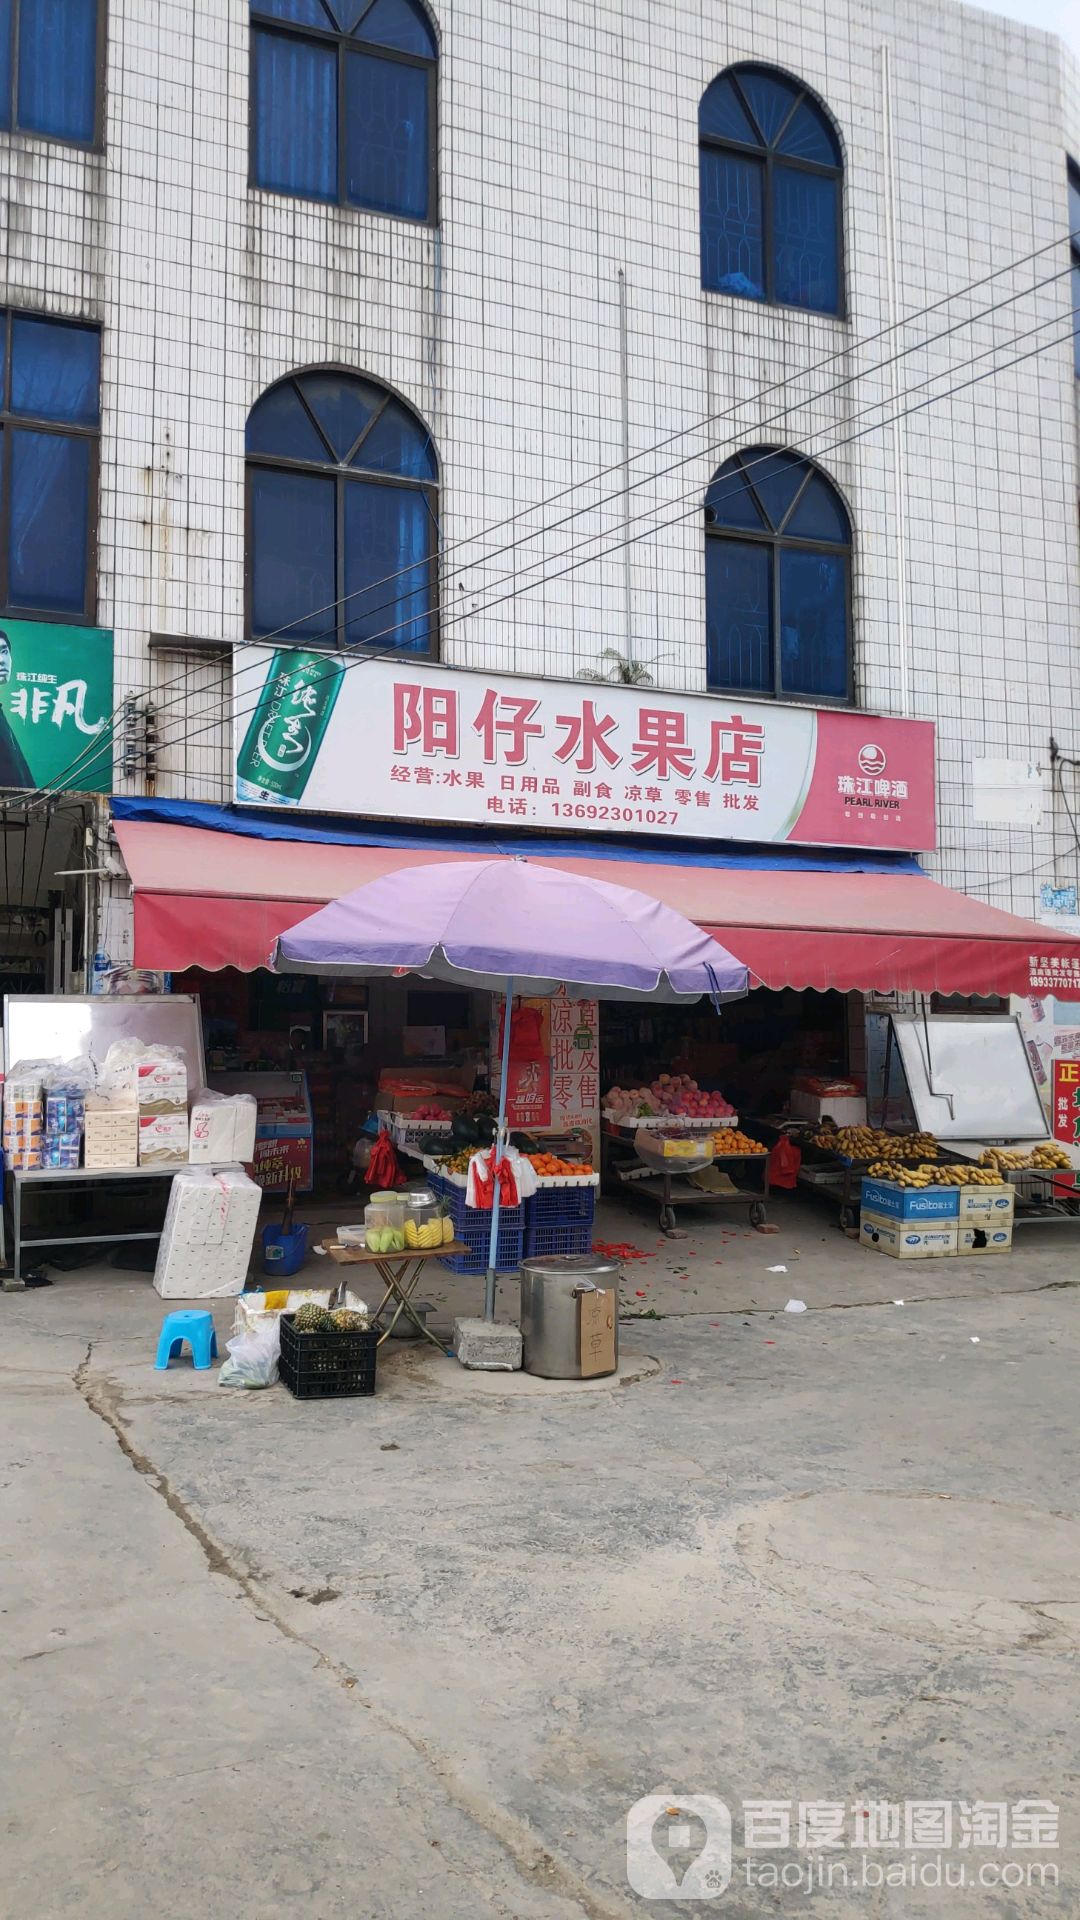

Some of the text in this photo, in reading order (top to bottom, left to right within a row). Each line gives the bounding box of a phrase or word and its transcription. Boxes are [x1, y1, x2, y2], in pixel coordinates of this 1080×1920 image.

[10, 679, 110, 735] 非凡
[393, 682, 765, 786] 阳仔水果店
[500, 775, 560, 794] 日用品
[573, 780, 613, 799] 副食
[624, 785, 662, 803] 凉草
[675, 789, 711, 807] 零售
[723, 793, 760, 811] 批发
[838, 776, 908, 799] 珠江啤酒
[844, 797, 901, 809] PEARL RIVER
[551, 803, 679, 825] 13692301027
[552, 999, 597, 1034] 凉草
[1058, 1063, 1080, 1083] 正
[552, 1075, 598, 1110] 零售
[1058, 1096, 1068, 1128] 批发
